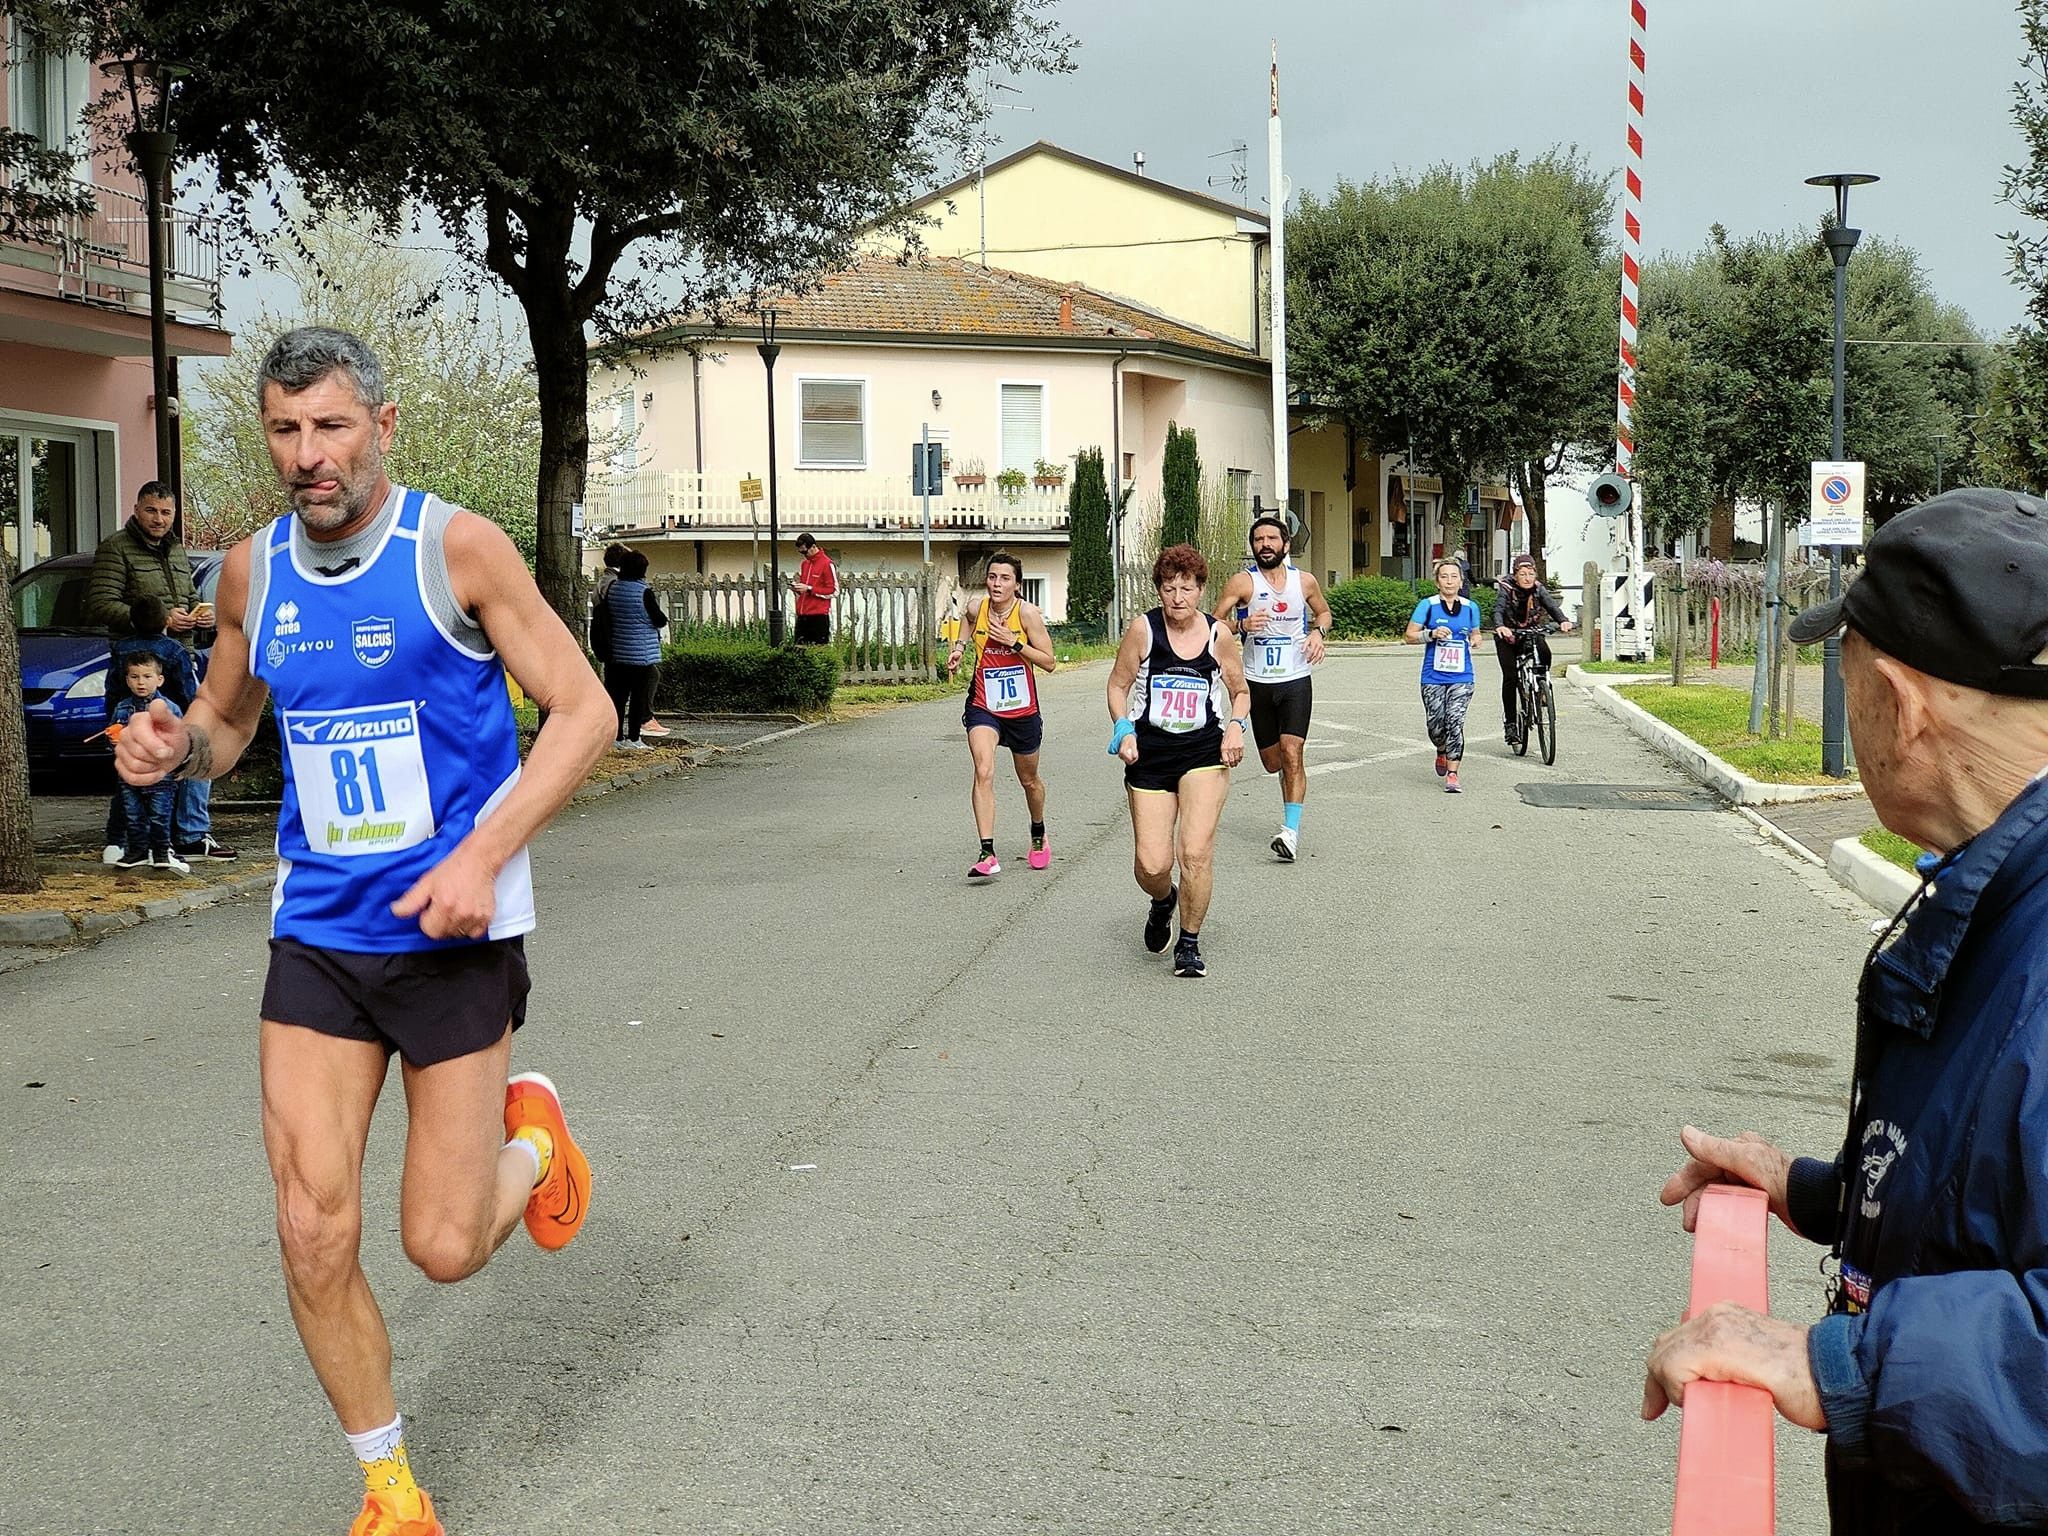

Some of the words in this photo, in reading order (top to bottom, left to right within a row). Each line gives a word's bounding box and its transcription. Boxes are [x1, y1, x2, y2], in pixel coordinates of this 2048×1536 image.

[285, 640, 335, 655] IT4YOU
[355, 632, 393, 649] SALCUS
[1266, 647, 1282, 667] 67
[1440, 648, 1460, 665] 244
[998, 678, 1018, 700] 76
[1161, 691, 1199, 719] 249
[330, 746, 386, 817] 81
